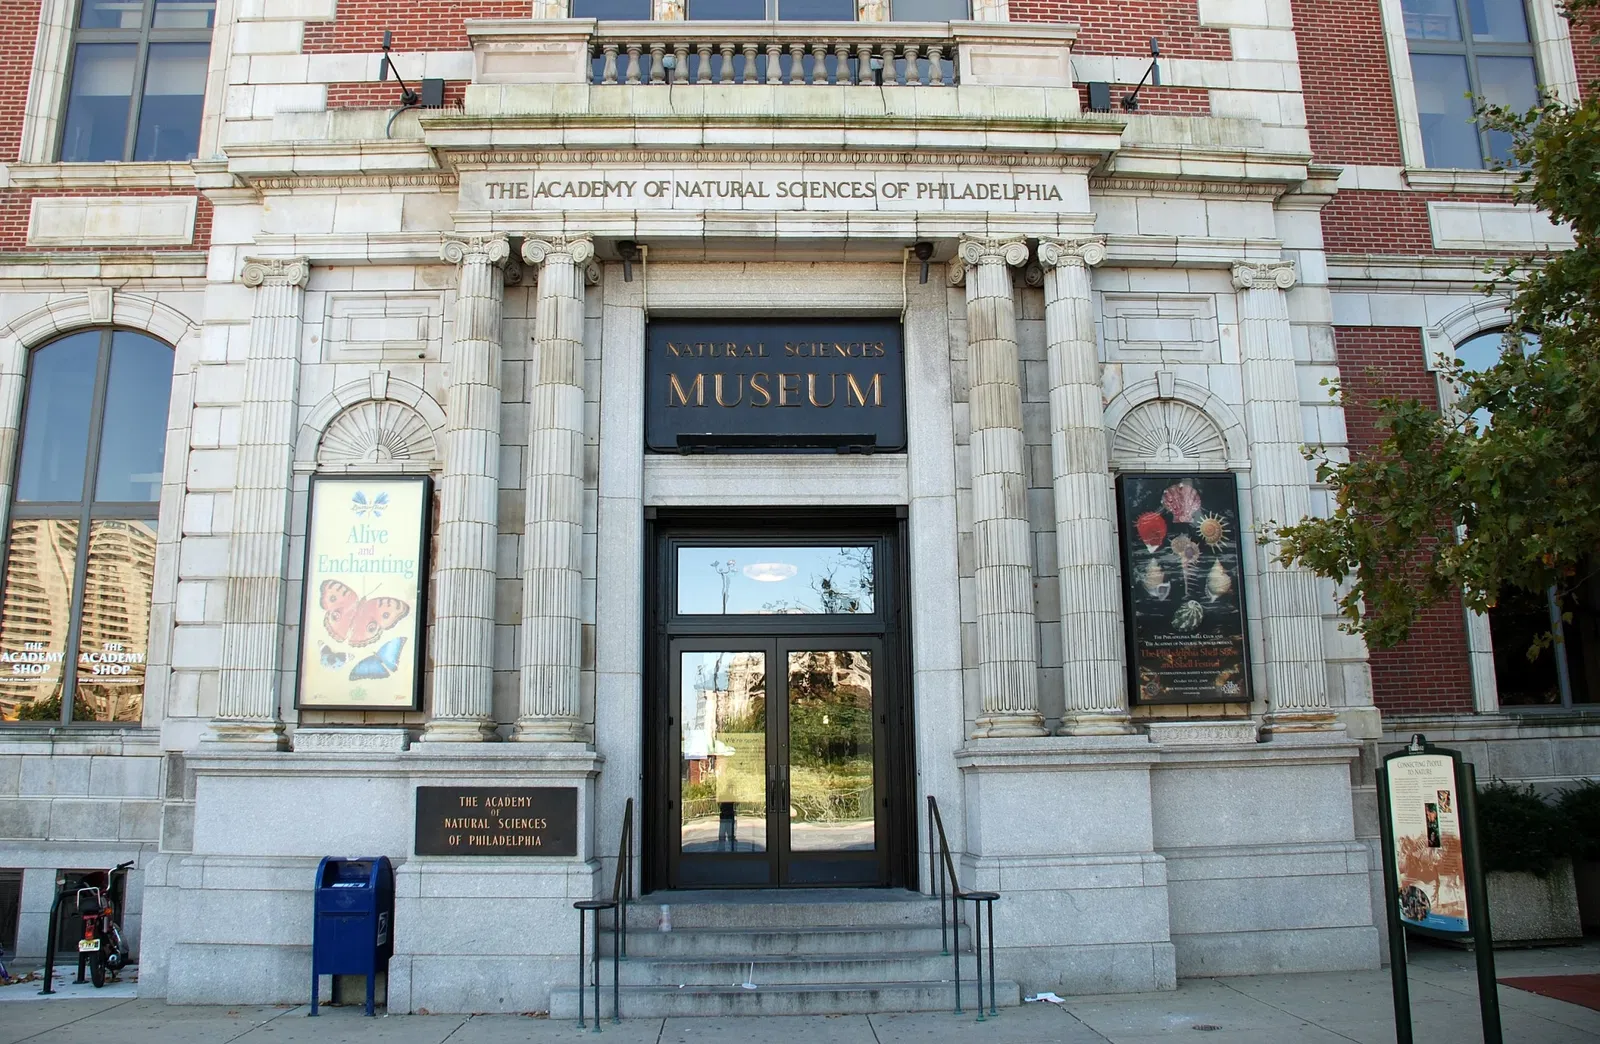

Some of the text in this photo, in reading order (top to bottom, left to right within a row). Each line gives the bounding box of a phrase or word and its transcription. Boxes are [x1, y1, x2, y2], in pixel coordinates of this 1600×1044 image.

[485, 181, 1063, 201] THE ACADEMY OF NATURAL SCIENCES OF PHILADELPHIA
[666, 342, 885, 358] NATURAL SCIENCES
[665, 372, 888, 408] MUSEUM
[345, 523, 389, 544] Alive
[358, 545, 374, 555] and
[318, 553, 415, 579] Enchanting
[24, 642, 44, 650] THE
[103, 643, 124, 651] THE
[1, 652, 66, 663] ACADEMY
[81, 652, 145, 663] ACADEMY
[12, 664, 51, 674] SHOP
[92, 664, 131, 675] SHOP
[1396, 759, 1443, 769] CONNECTING PEOPLE
[1414, 768, 1433, 776] NATURE
[459, 796, 533, 807] THE ACADEMY
[444, 818, 547, 829] NATURAL SCIENCES
[448, 835, 542, 846] OF PHILADELPHIA
